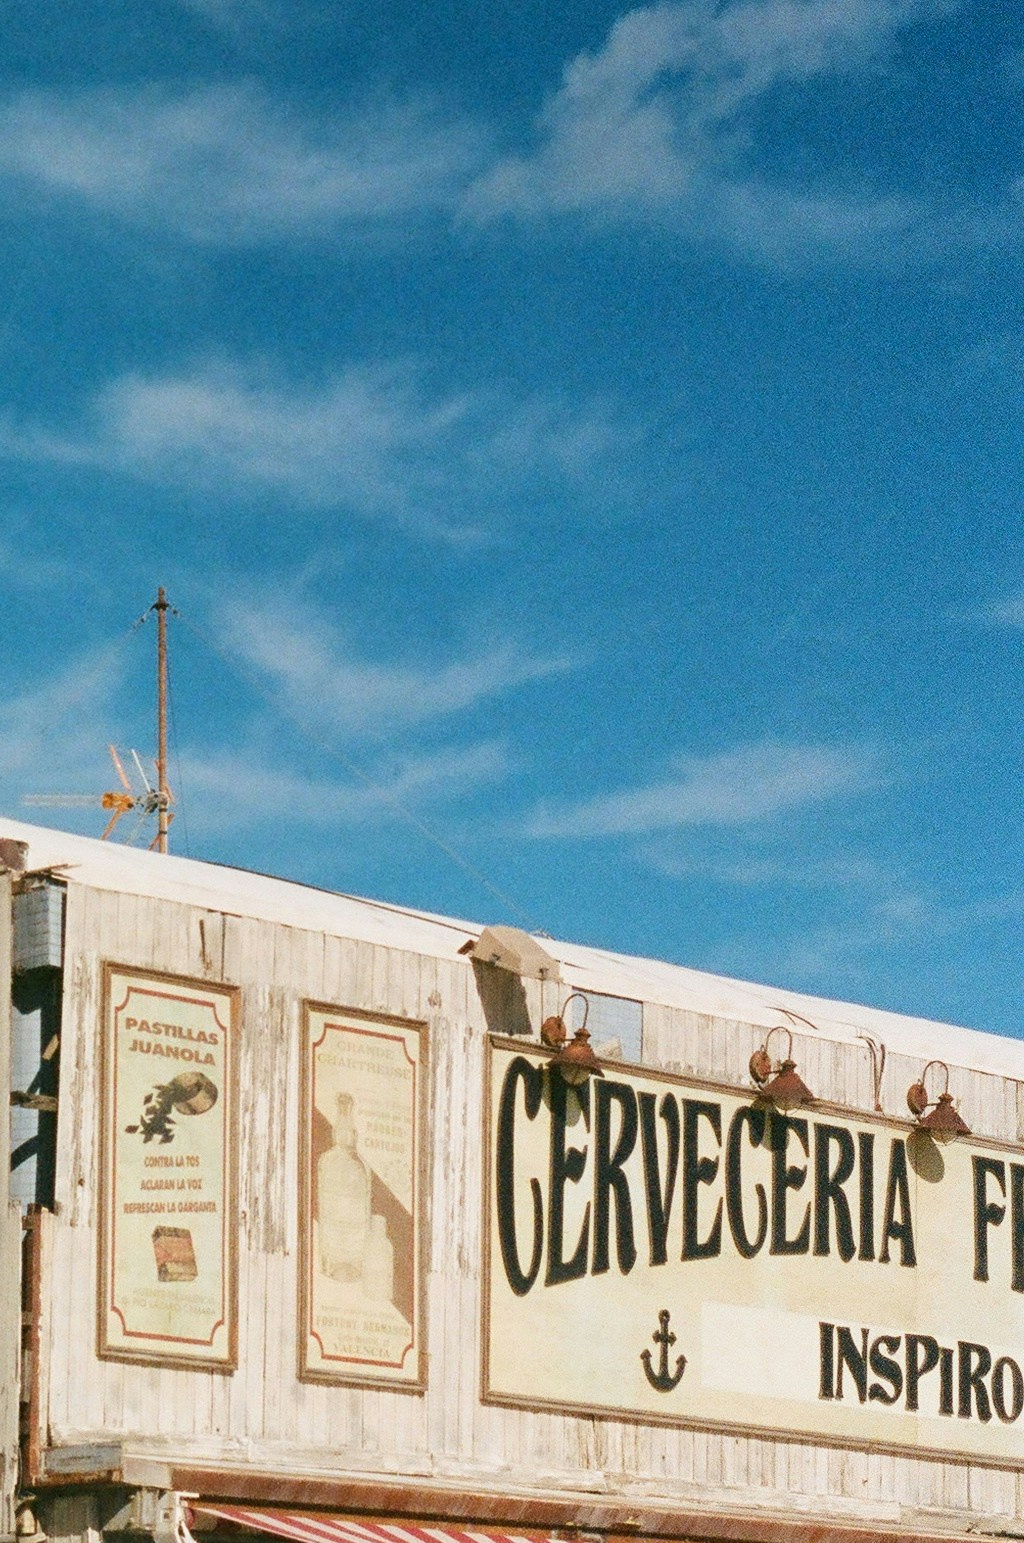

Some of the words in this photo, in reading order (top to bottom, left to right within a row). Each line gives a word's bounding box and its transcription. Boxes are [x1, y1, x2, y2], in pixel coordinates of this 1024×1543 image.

[125, 1017, 219, 1045] PASTILLAS
[128, 1039, 216, 1067] JUANOLA
[336, 1041, 394, 1060] GRANDE
[144, 1156, 173, 1168] CONTRA
[175, 1156, 184, 1167] LA
[185, 1155, 201, 1167] TOS
[140, 1179, 175, 1191] ACLARAN
[177, 1179, 185, 1190] LA
[187, 1179, 202, 1190] VOZ
[496, 1055, 918, 1297] CERVECERIA
[123, 1202, 165, 1214] REFRESCAN
[167, 1202, 176, 1213] LA
[178, 1201, 216, 1214] GARGANTA
[818, 1321, 1024, 1424] INSPIRO
